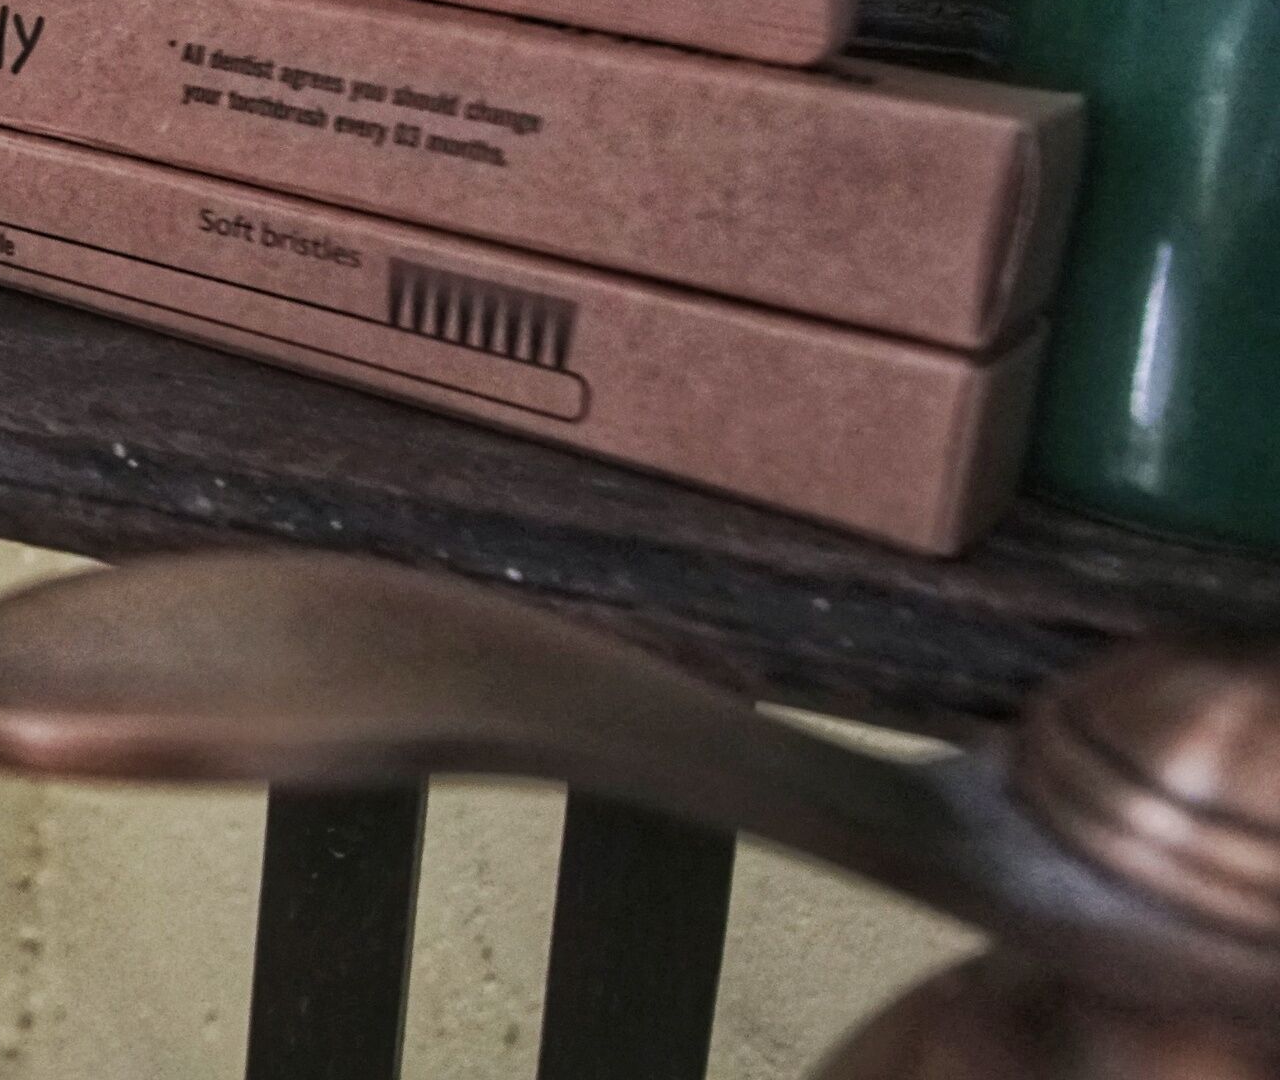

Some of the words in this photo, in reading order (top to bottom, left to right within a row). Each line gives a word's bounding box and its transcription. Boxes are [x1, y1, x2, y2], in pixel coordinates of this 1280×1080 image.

[228, 90, 330, 129] toothbrush
[198, 208, 256, 243] Soft
[260, 221, 363, 269] bristles
